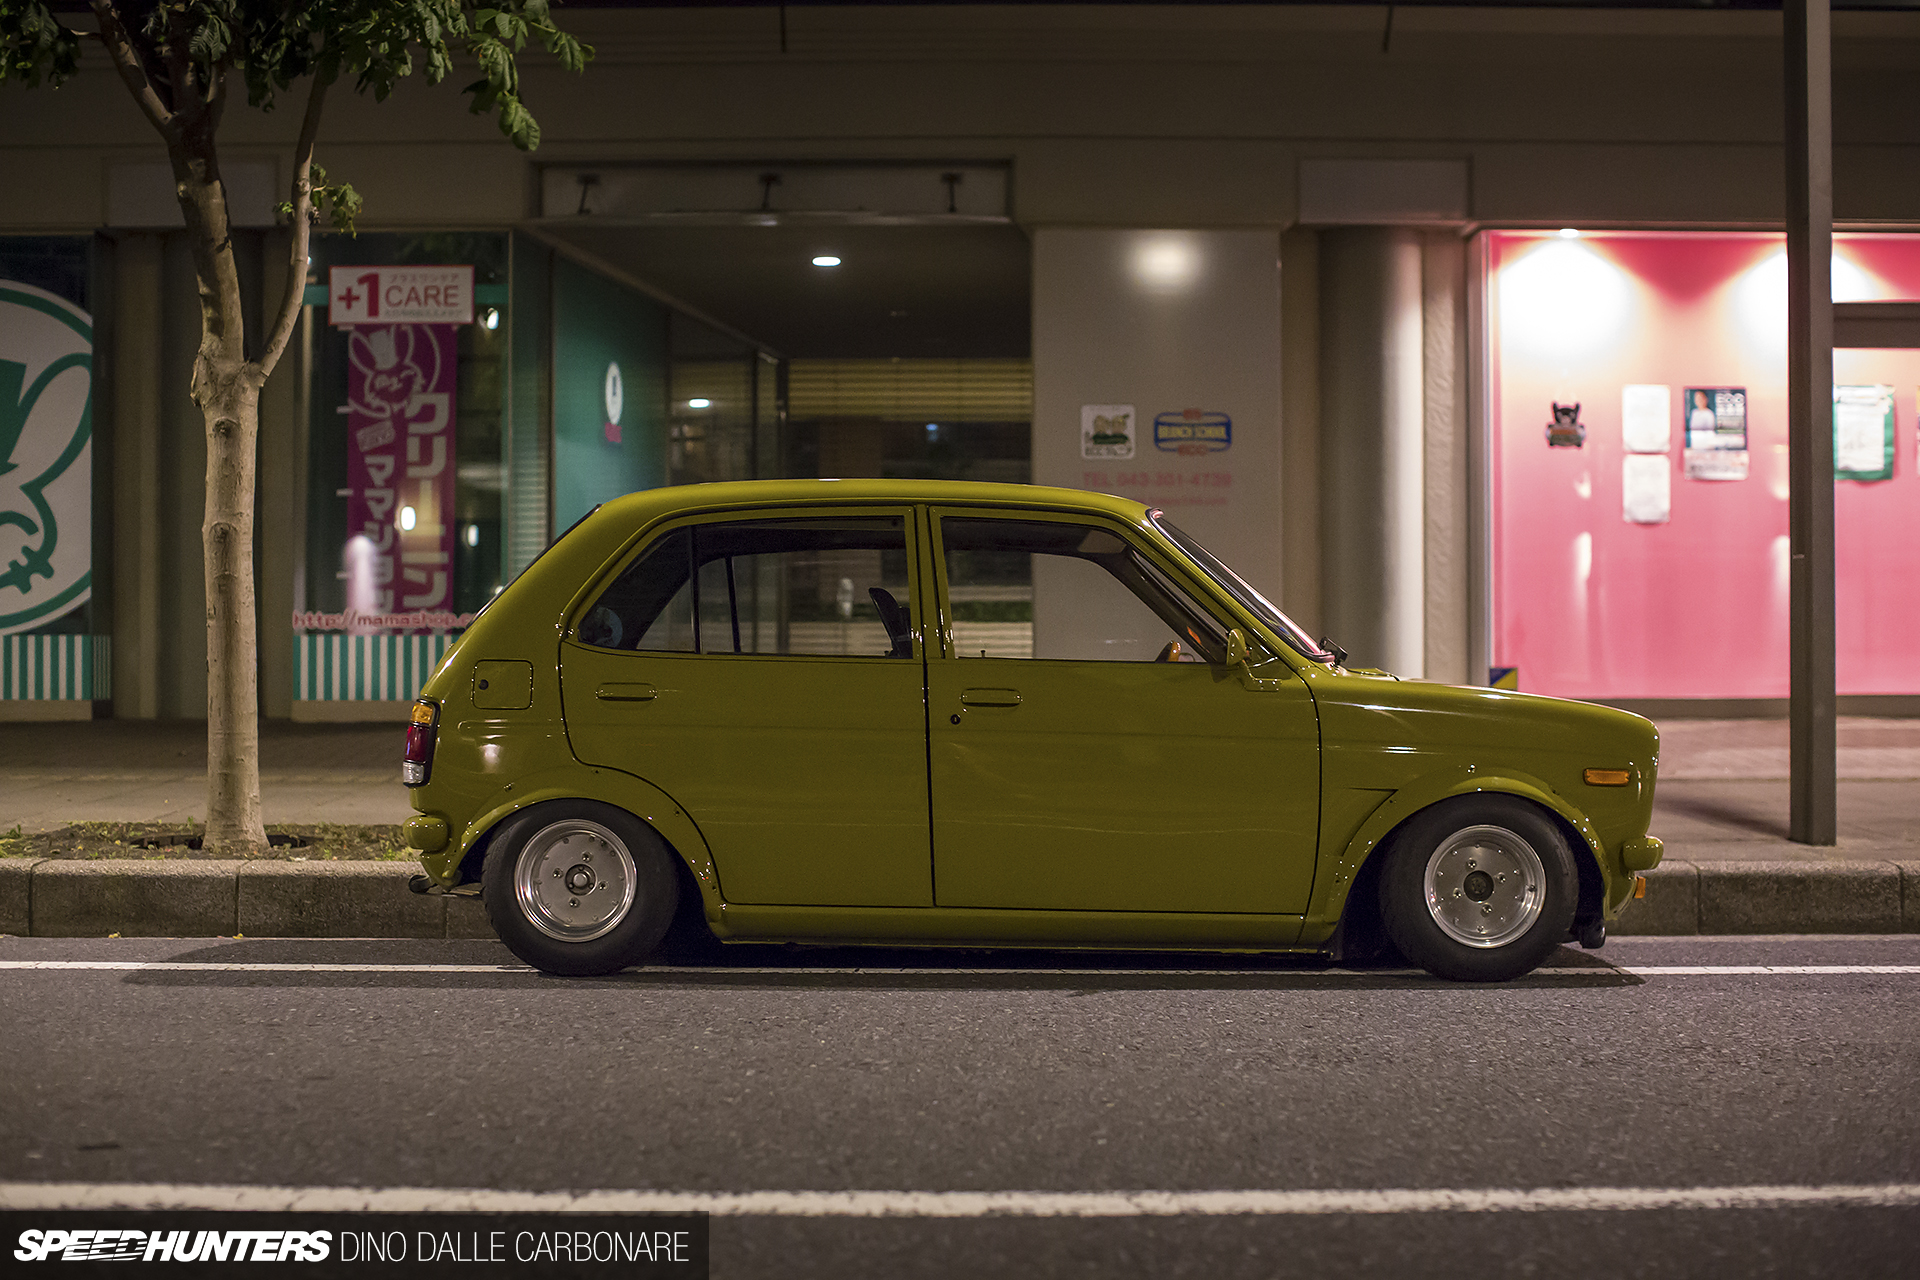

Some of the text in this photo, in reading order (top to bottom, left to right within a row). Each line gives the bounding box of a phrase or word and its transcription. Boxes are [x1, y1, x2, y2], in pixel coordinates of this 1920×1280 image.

[337, 272, 379, 317] +1
[385, 285, 460, 307] CARE
[401, 392, 450, 634] クリーニン
